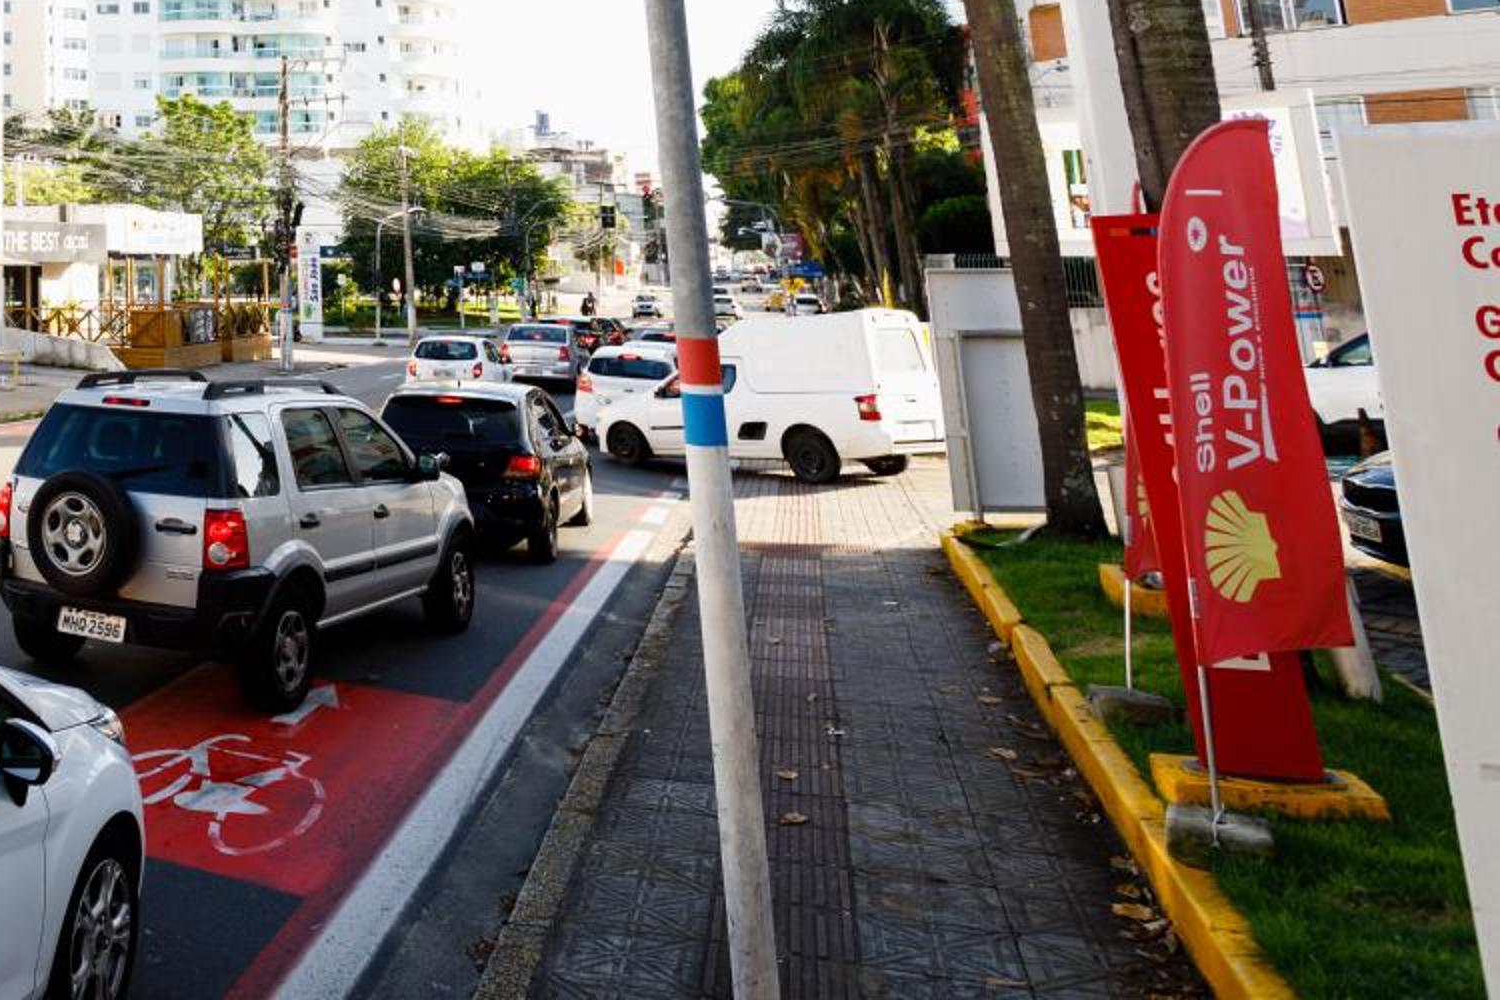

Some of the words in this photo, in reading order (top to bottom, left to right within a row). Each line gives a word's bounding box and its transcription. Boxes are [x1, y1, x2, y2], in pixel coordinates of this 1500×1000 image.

[3, 230, 30, 251] THE
[31, 230, 61, 252] BEST
[1219, 234, 1261, 469] V-Power
[1189, 371, 1217, 473] Shell
